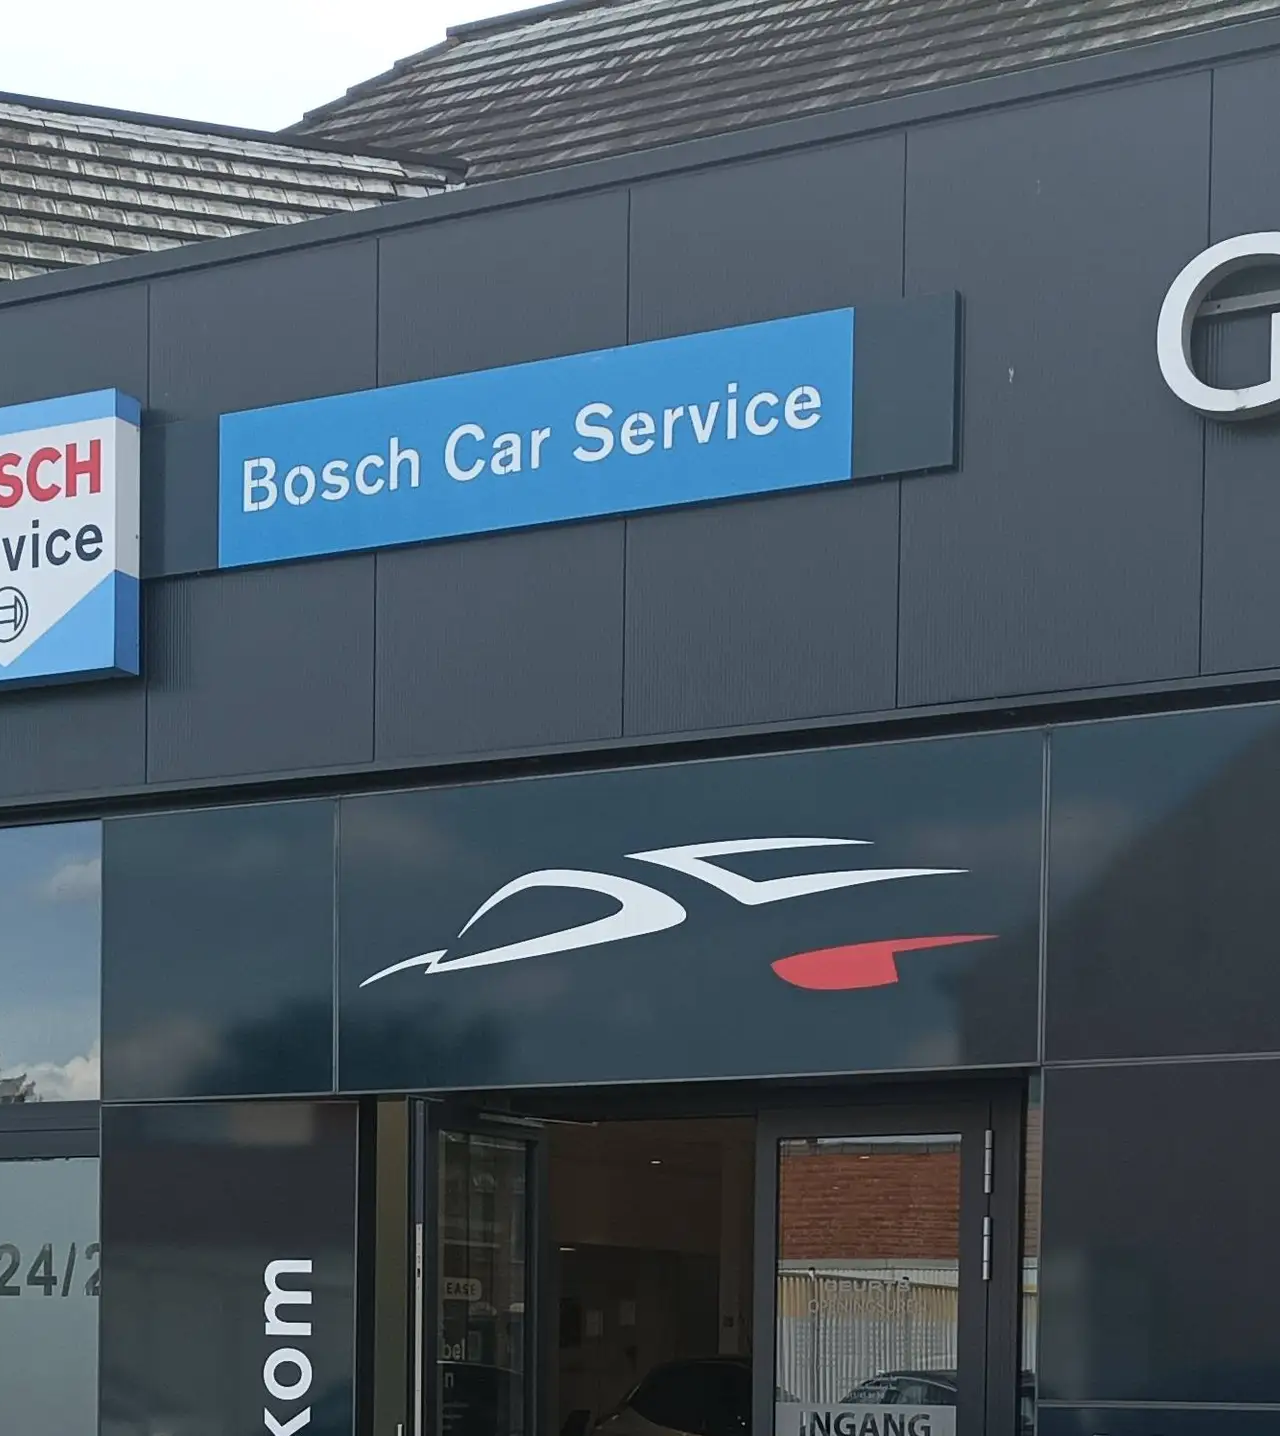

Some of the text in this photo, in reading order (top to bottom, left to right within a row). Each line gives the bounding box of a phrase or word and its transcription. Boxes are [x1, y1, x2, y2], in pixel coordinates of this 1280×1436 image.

[242, 381, 823, 513] Bosch Car Service
